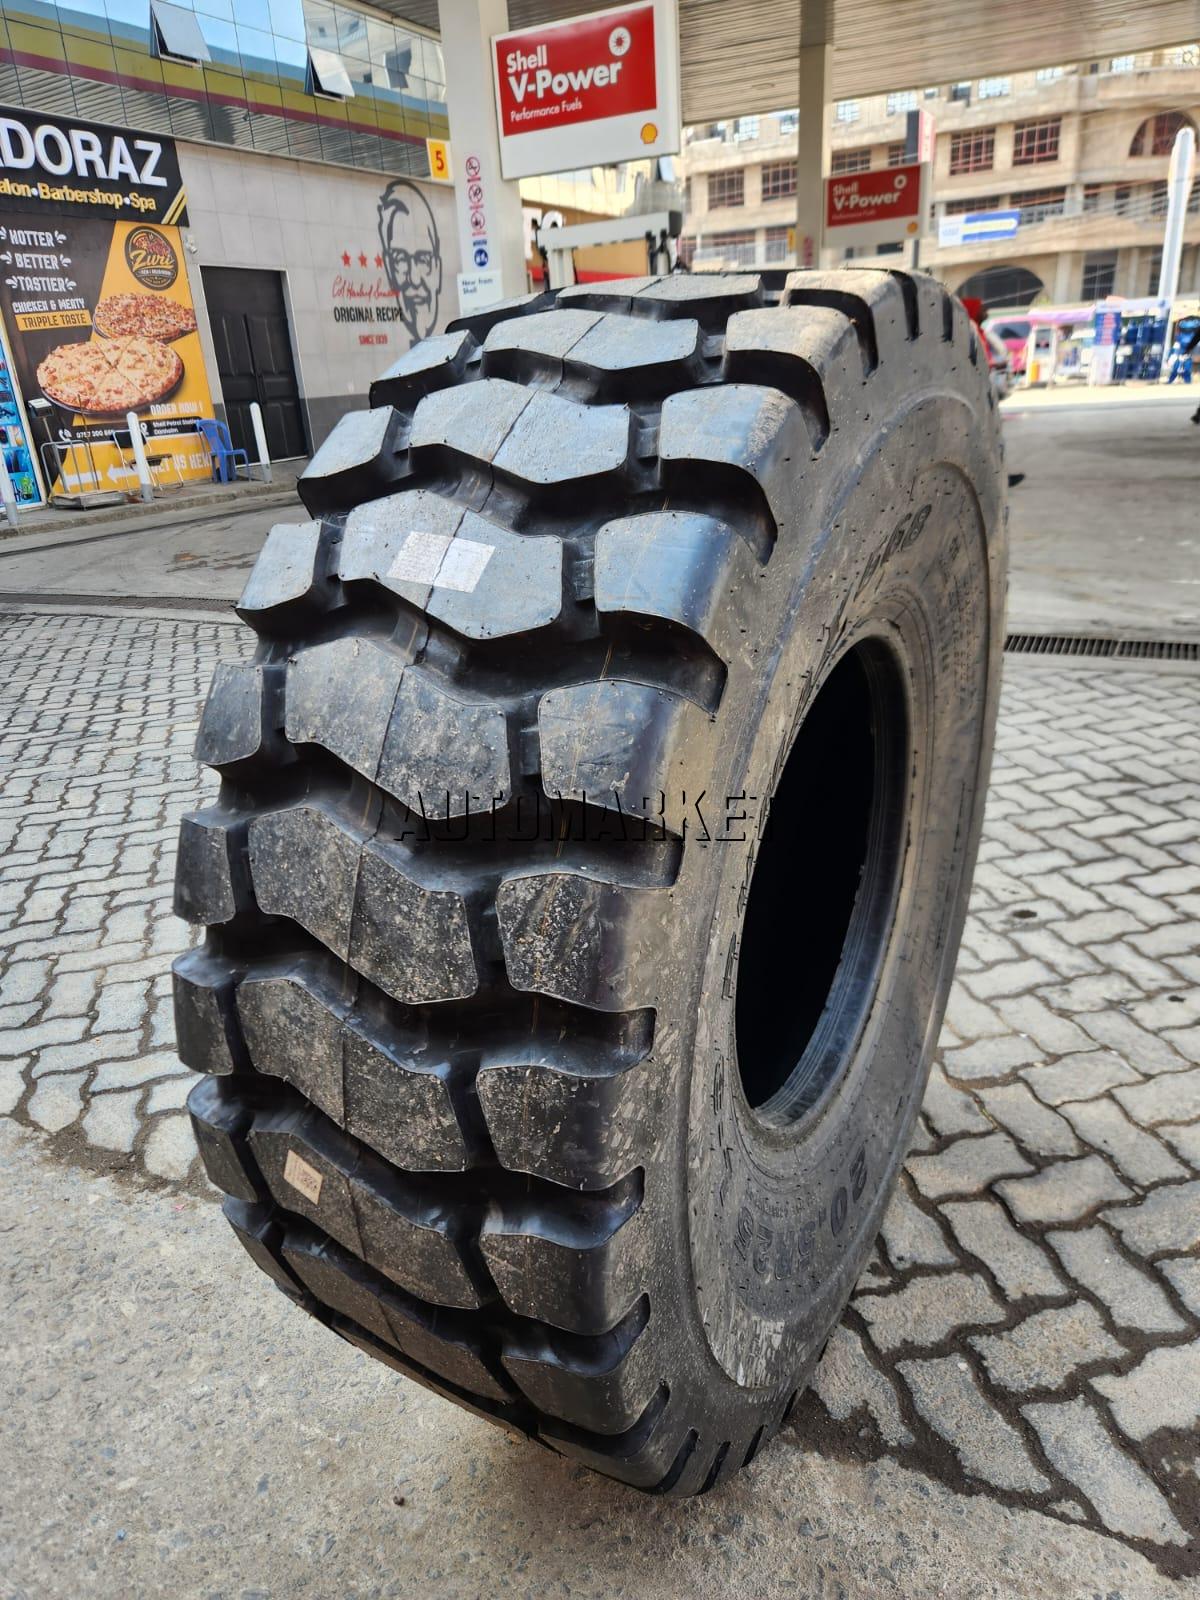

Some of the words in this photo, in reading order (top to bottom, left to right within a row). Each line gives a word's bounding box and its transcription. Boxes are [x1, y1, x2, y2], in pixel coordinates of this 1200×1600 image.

[506, 44, 547, 73] Shell
[508, 61, 622, 103] V-Power
[510, 104, 560, 122] Performance
[561, 97, 583, 113] Fuels
[0, 117, 168, 187] DORAZ
[435, 151, 445, 171] 5
[832, 181, 859, 196] Shell
[128, 192, 157, 212] Spa
[833, 191, 901, 211] V-Power
[9, 229, 55, 248] HOTTER
[14, 252, 60, 270] BETTER
[17, 275, 67, 292] TASTIER
[12, 300, 49, 313] CHICKEN
[57, 297, 85, 310] MEATY
[333, 306, 375, 323] ORIGINAL
[22, 314, 59, 328] TRIPPLE
[60, 312, 87, 326] TASTE
